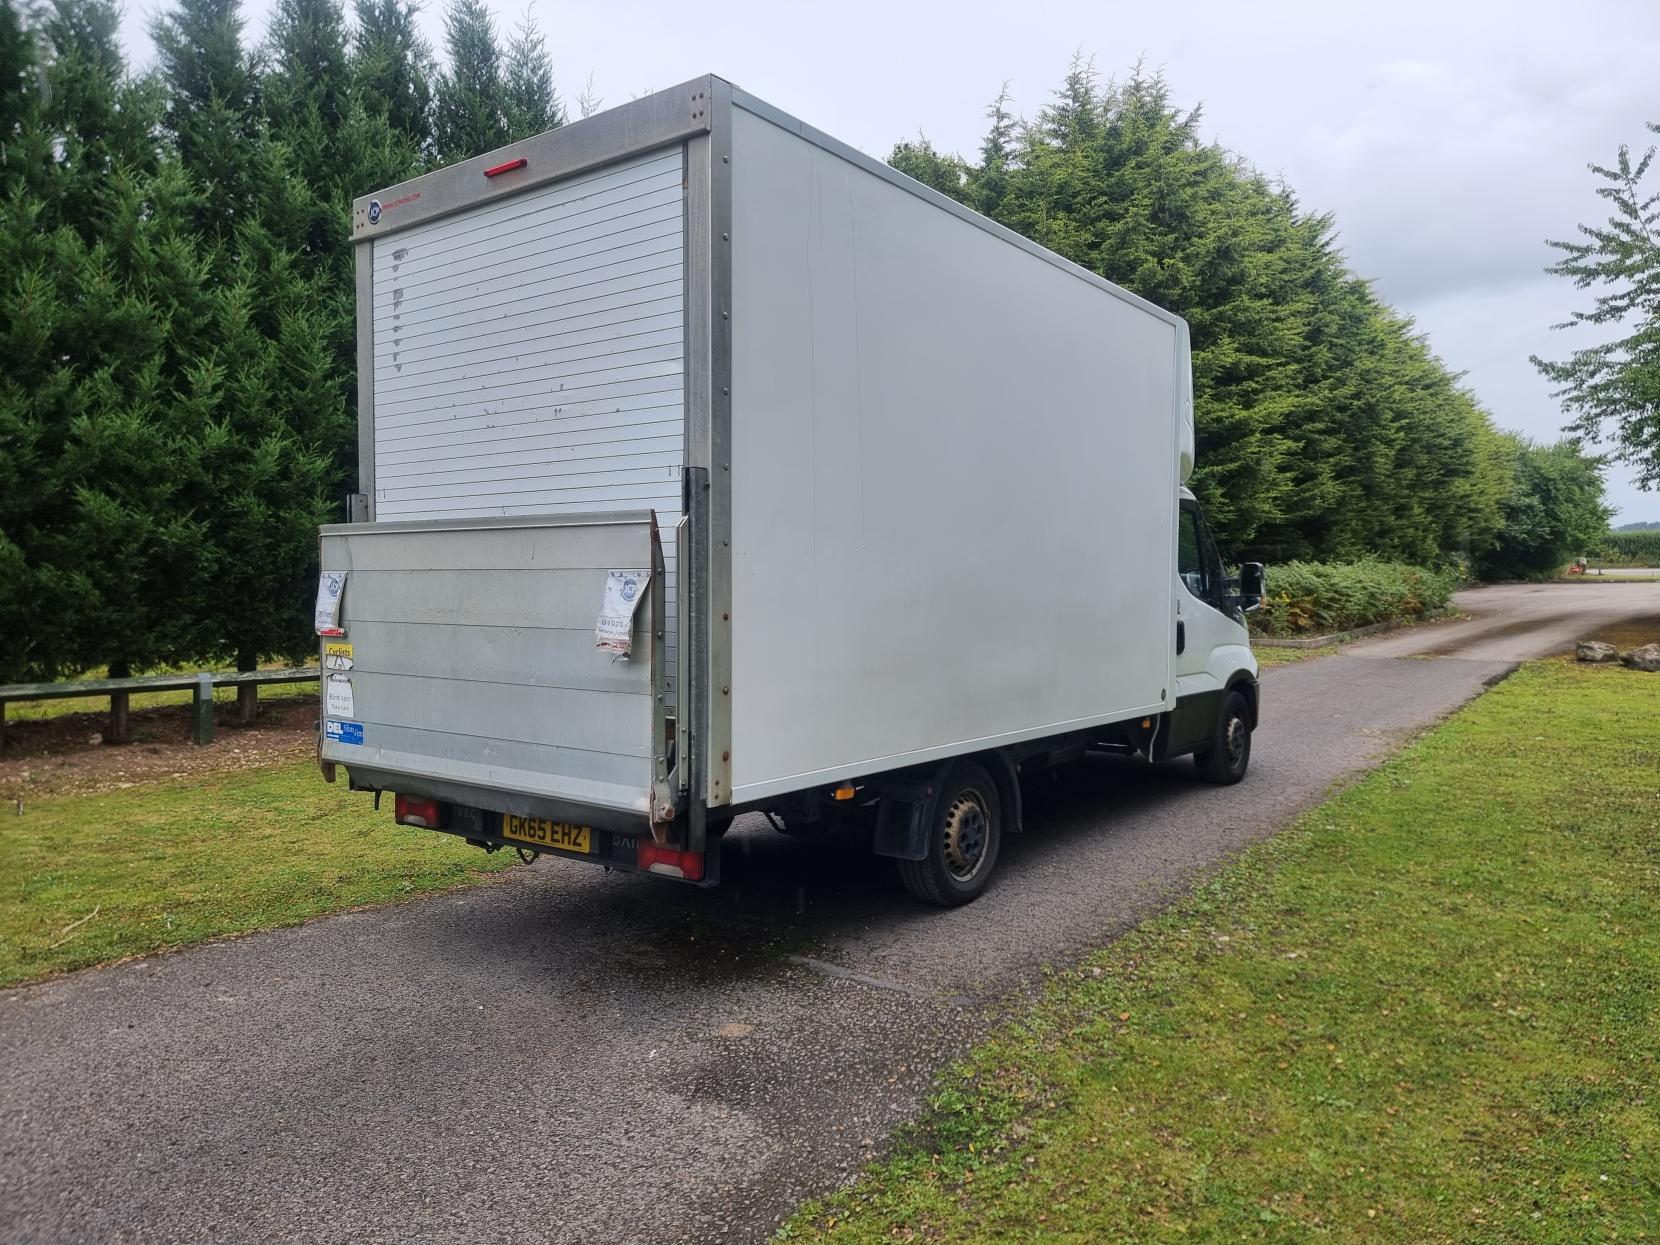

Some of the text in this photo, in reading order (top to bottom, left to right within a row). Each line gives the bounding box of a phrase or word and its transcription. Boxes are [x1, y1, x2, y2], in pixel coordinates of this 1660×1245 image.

[601, 619, 623, 627] 01922
[328, 647, 351, 657] Cyclists
[327, 721, 343, 733] DEL
[508, 815, 583, 848] GK65 EHZ
[612, 835, 639, 849] DAI
